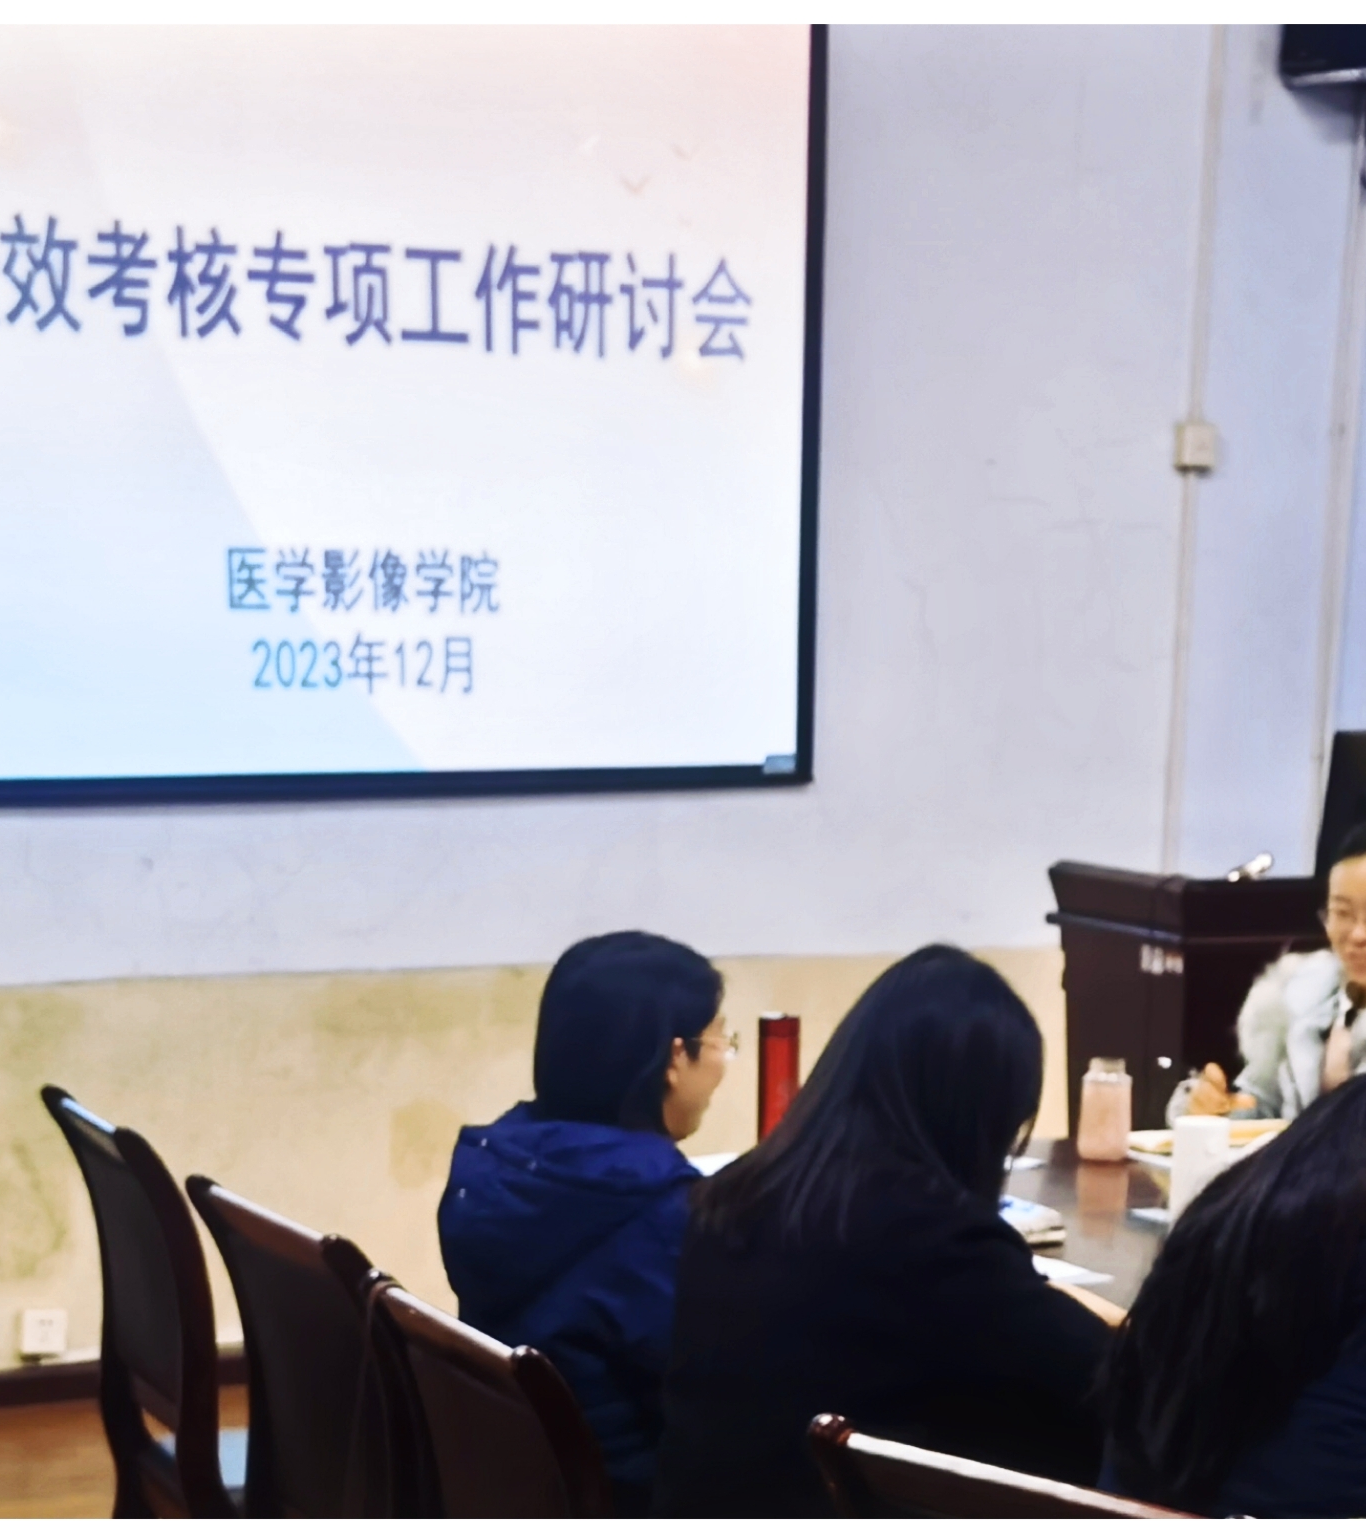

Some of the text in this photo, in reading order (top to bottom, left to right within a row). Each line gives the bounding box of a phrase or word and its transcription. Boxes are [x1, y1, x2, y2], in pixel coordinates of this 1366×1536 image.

[225, 545, 502, 615] 医学影像学院
[250, 632, 477, 697] 2023年12月
